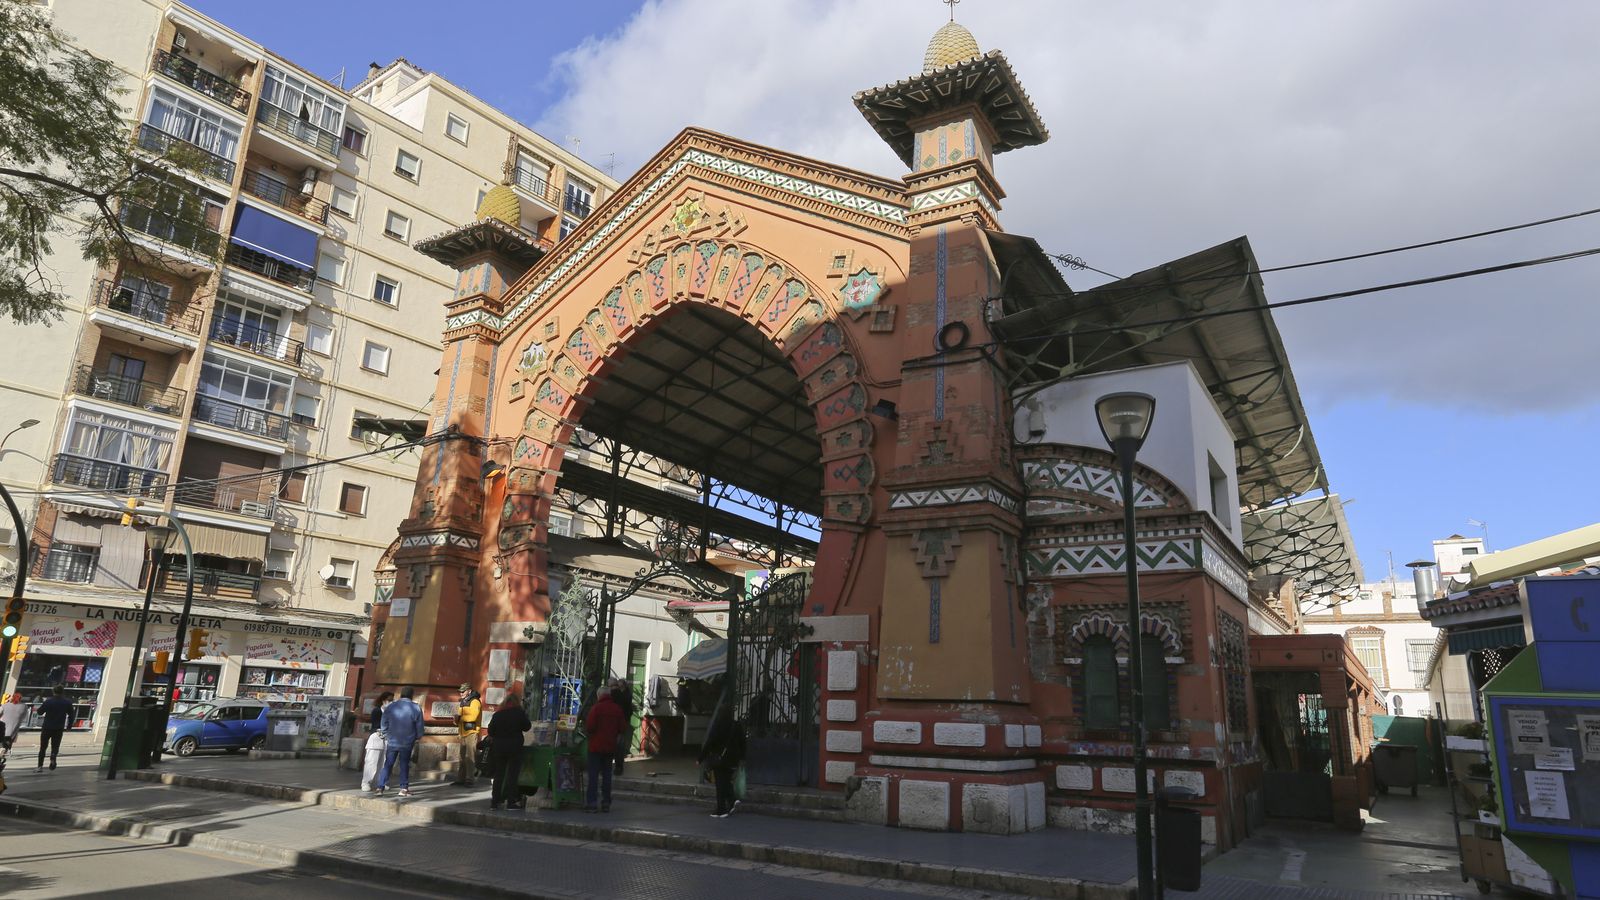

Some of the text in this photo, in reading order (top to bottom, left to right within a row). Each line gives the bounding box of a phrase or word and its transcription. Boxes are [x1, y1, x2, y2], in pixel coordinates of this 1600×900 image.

[41, 605, 57, 615] 726
[86, 608, 105, 619] LA
[113, 610, 163, 624] NUEVA
[32, 627, 60, 637] Menaje
[244, 623, 322, 637] 619 857 351 622 013 726
[39, 636, 65, 644] Hogar
